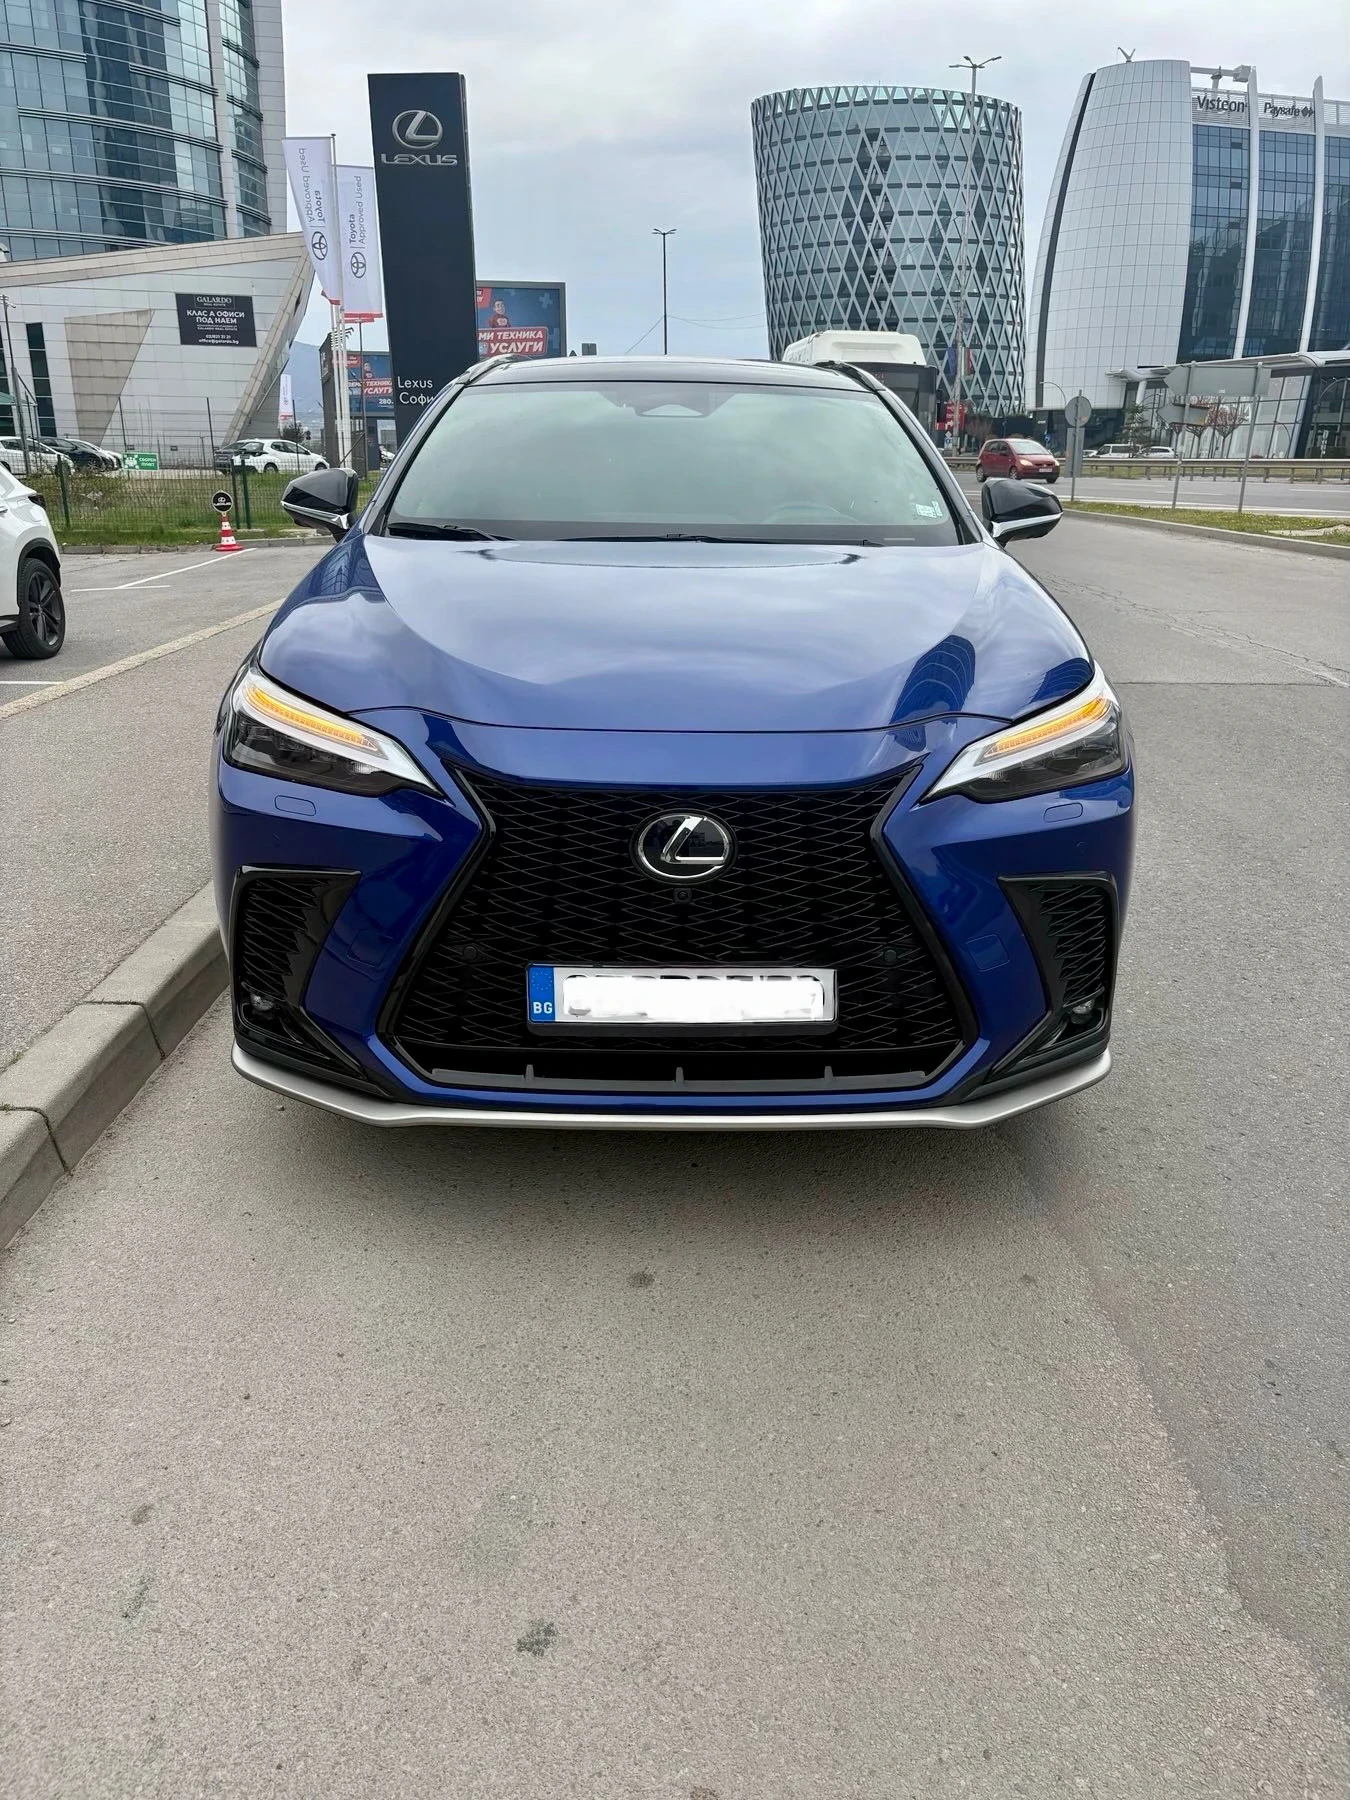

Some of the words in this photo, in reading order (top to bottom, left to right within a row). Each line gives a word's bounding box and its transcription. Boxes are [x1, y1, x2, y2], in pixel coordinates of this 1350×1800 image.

[1197, 96, 1245, 113] Visteon
[1264, 102, 1300, 117] Paysafe
[381, 153, 458, 166] LEXUS
[354, 175, 363, 198] Used
[356, 201, 366, 244] Approved
[196, 296, 232, 304] GALARDO
[478, 331, 494, 340] МИ
[496, 331, 543, 340] ТЕХНИКА
[490, 341, 543, 353] УСЛУГИ
[397, 376, 433, 388] Lexus
[399, 392, 434, 406] Софи
[533, 1001, 553, 1014] BG
